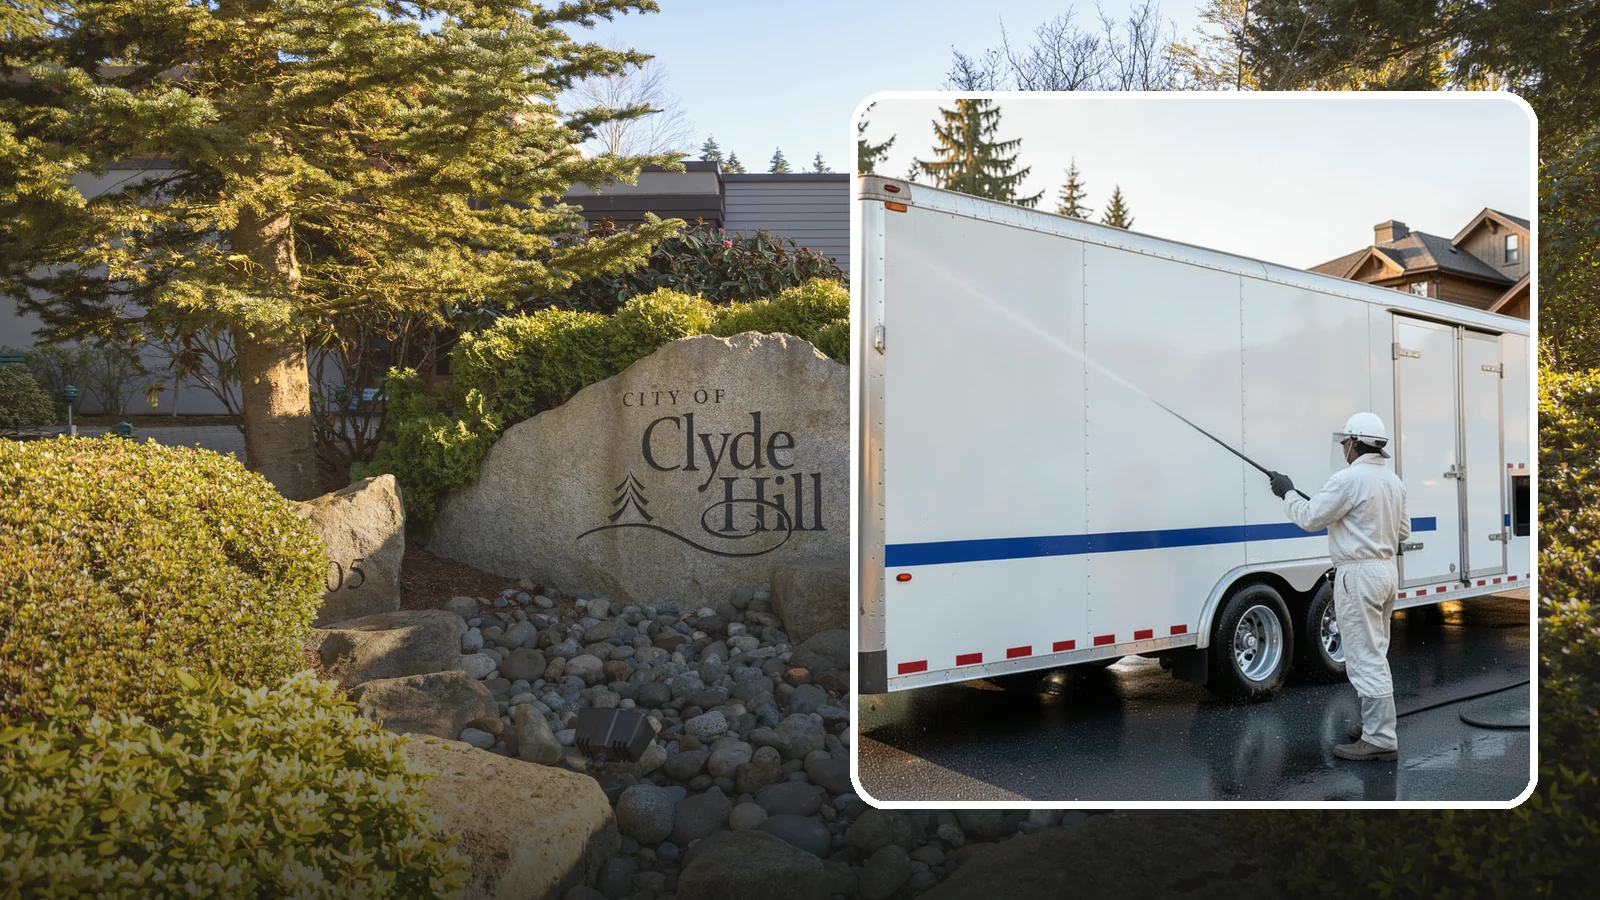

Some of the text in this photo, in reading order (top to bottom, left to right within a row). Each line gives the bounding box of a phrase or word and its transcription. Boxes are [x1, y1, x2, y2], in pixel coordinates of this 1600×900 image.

[623, 389, 725, 407] CITY OF
[642, 411, 795, 493] Clyde
[719, 472, 828, 532] Hill
